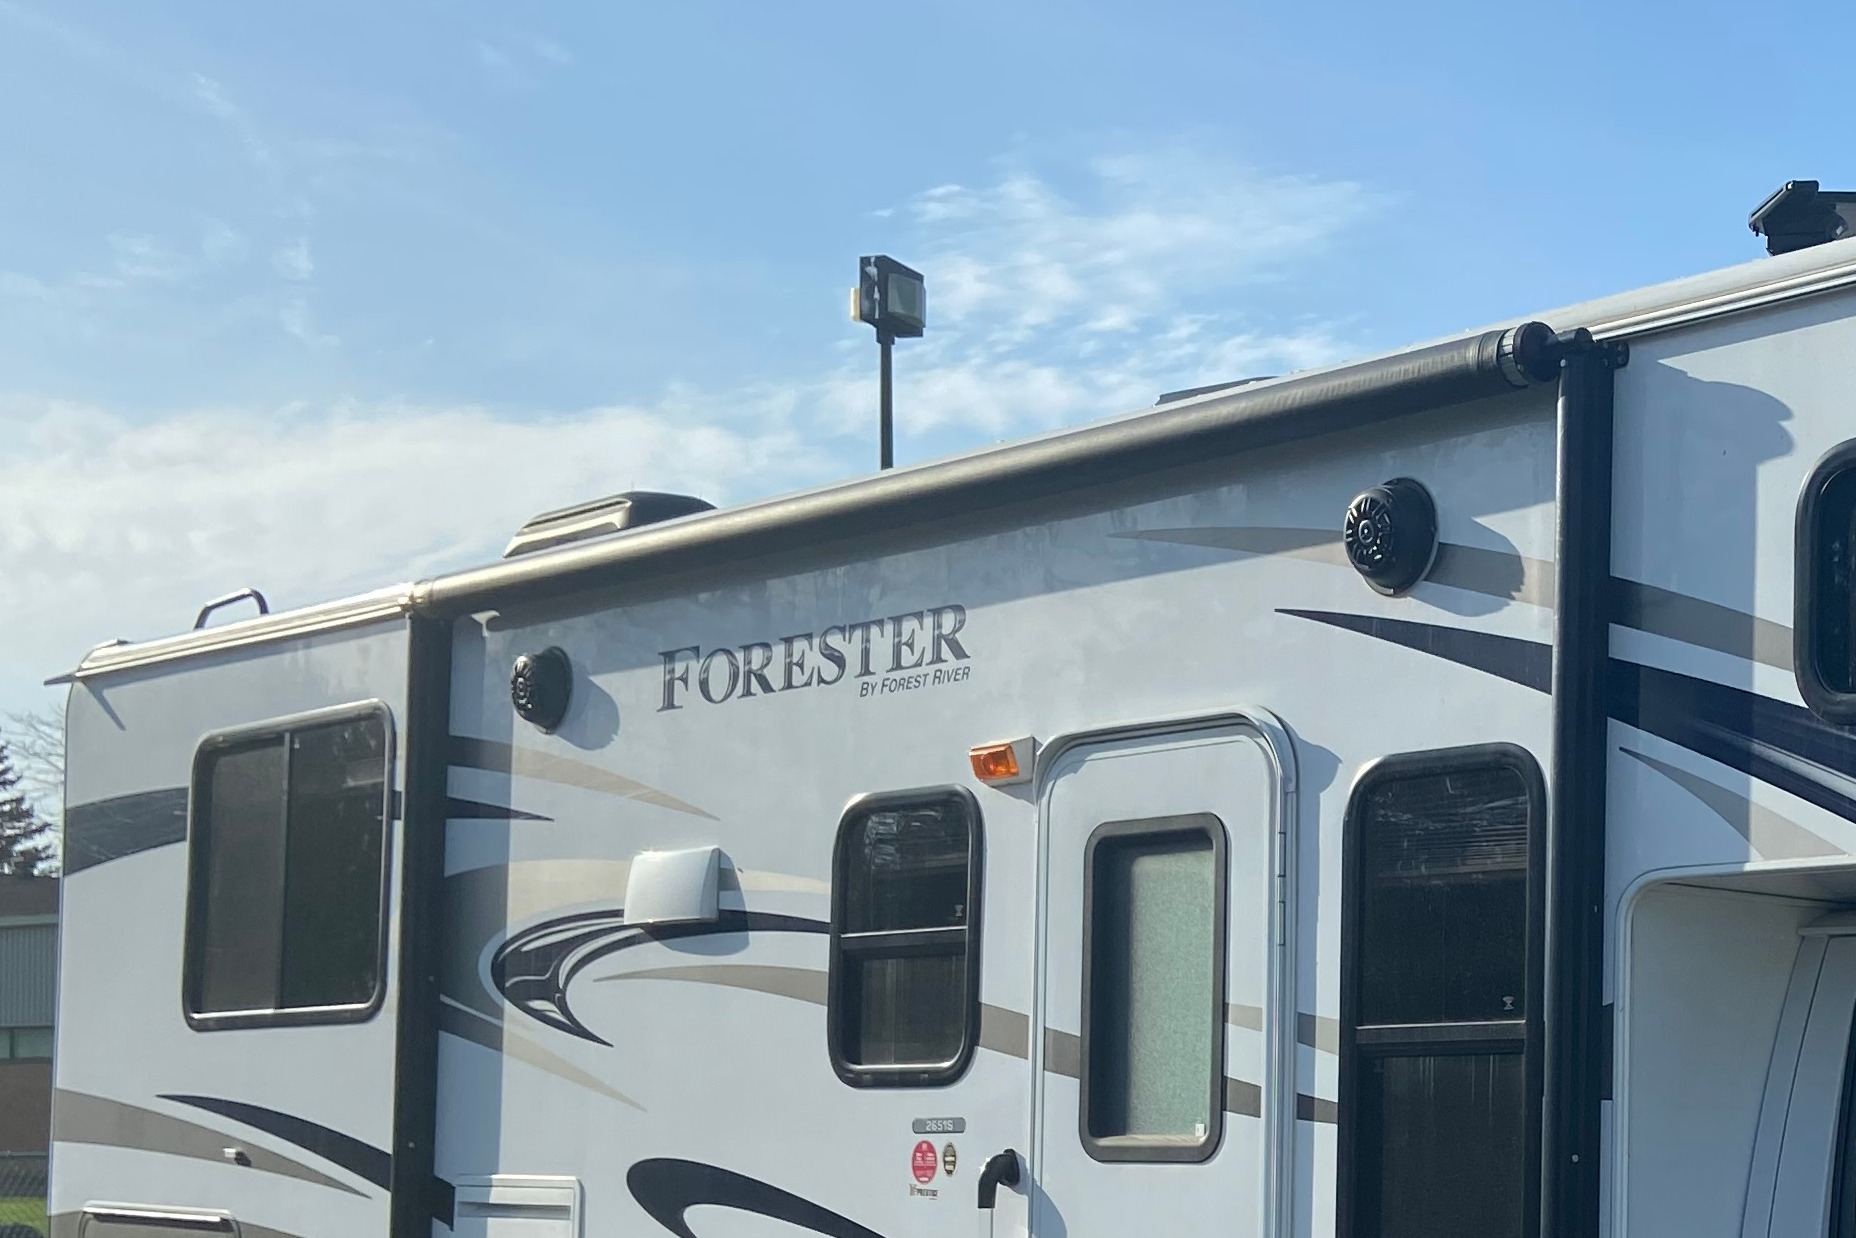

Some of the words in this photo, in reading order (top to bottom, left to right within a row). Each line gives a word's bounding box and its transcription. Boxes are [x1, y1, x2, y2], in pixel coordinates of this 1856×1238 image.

[656, 603, 971, 713] FORESTER
[859, 681, 878, 698] BY
[880, 673, 930, 695] FOREST
[932, 666, 971, 686] RIVER
